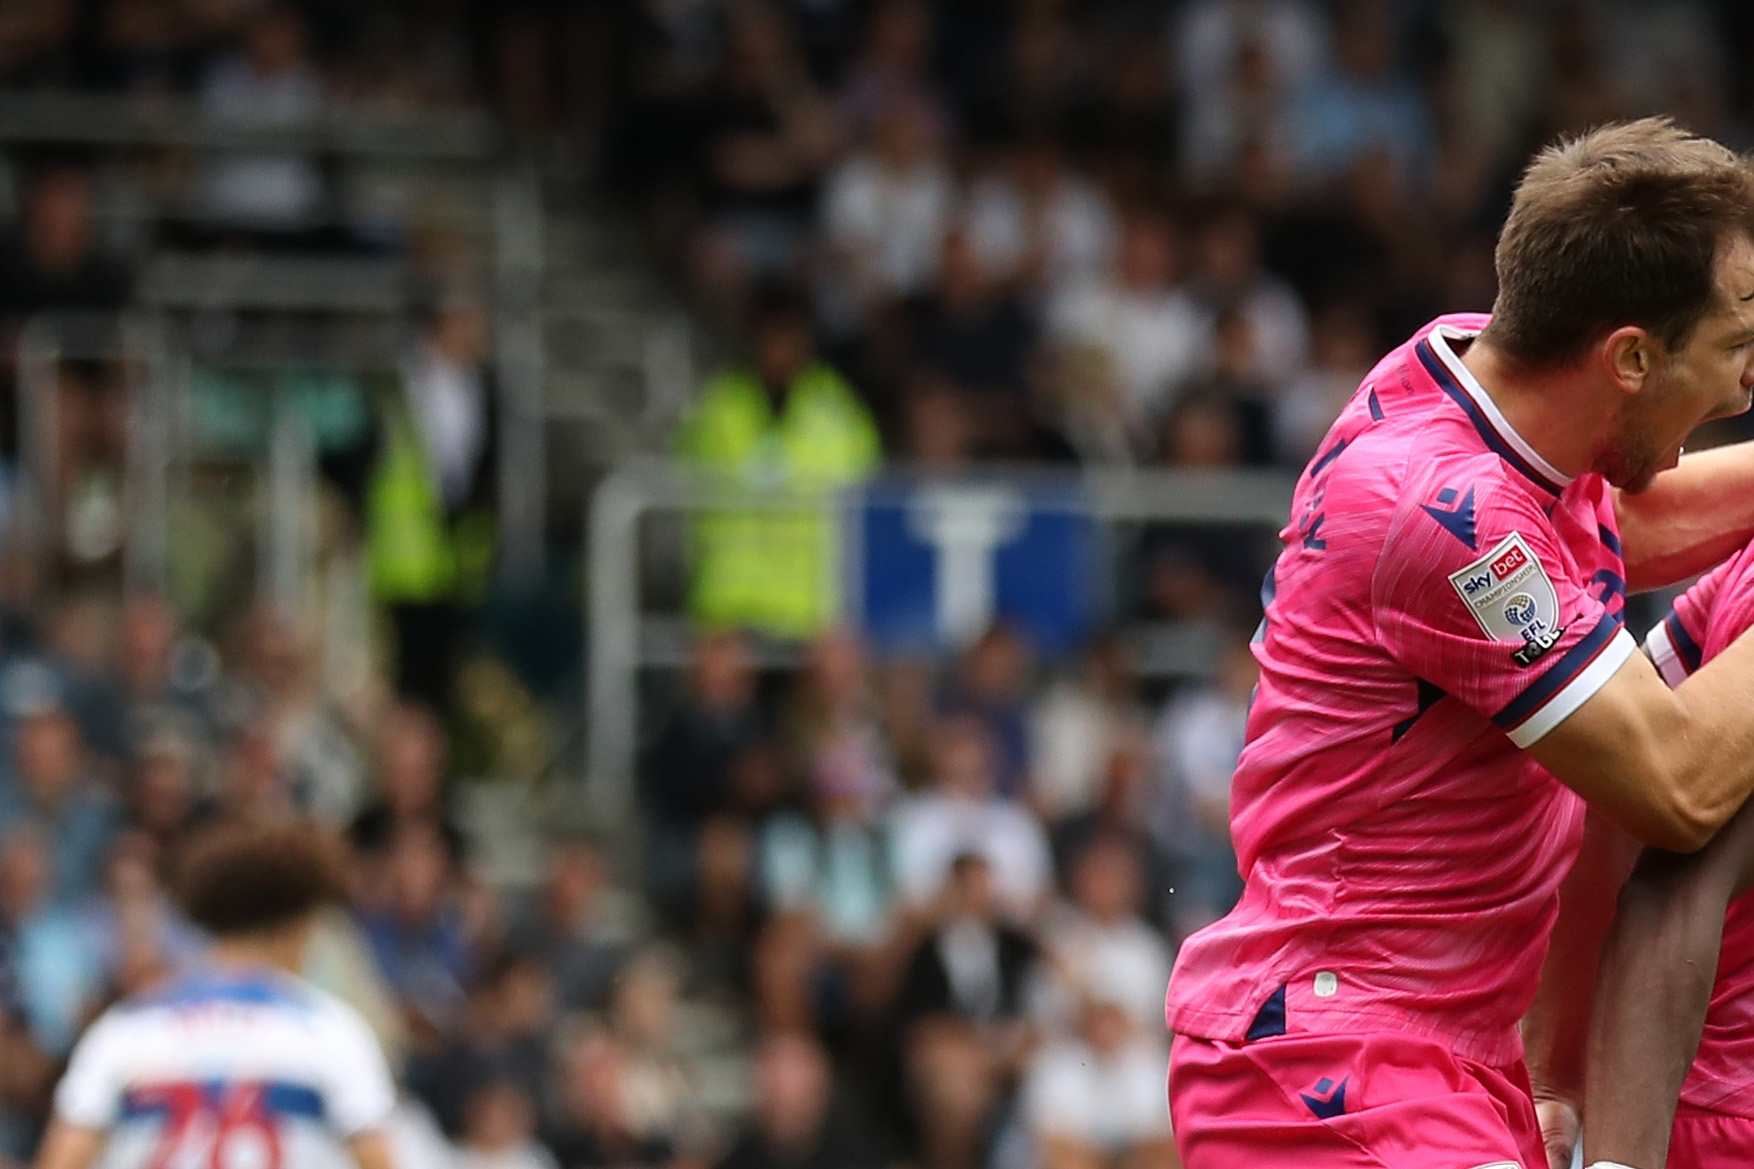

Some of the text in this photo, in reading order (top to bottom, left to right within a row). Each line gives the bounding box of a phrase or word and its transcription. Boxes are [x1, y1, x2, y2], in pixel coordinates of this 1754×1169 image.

[1463, 548, 1524, 595] sky bet
[1519, 619, 1547, 642] EFL
